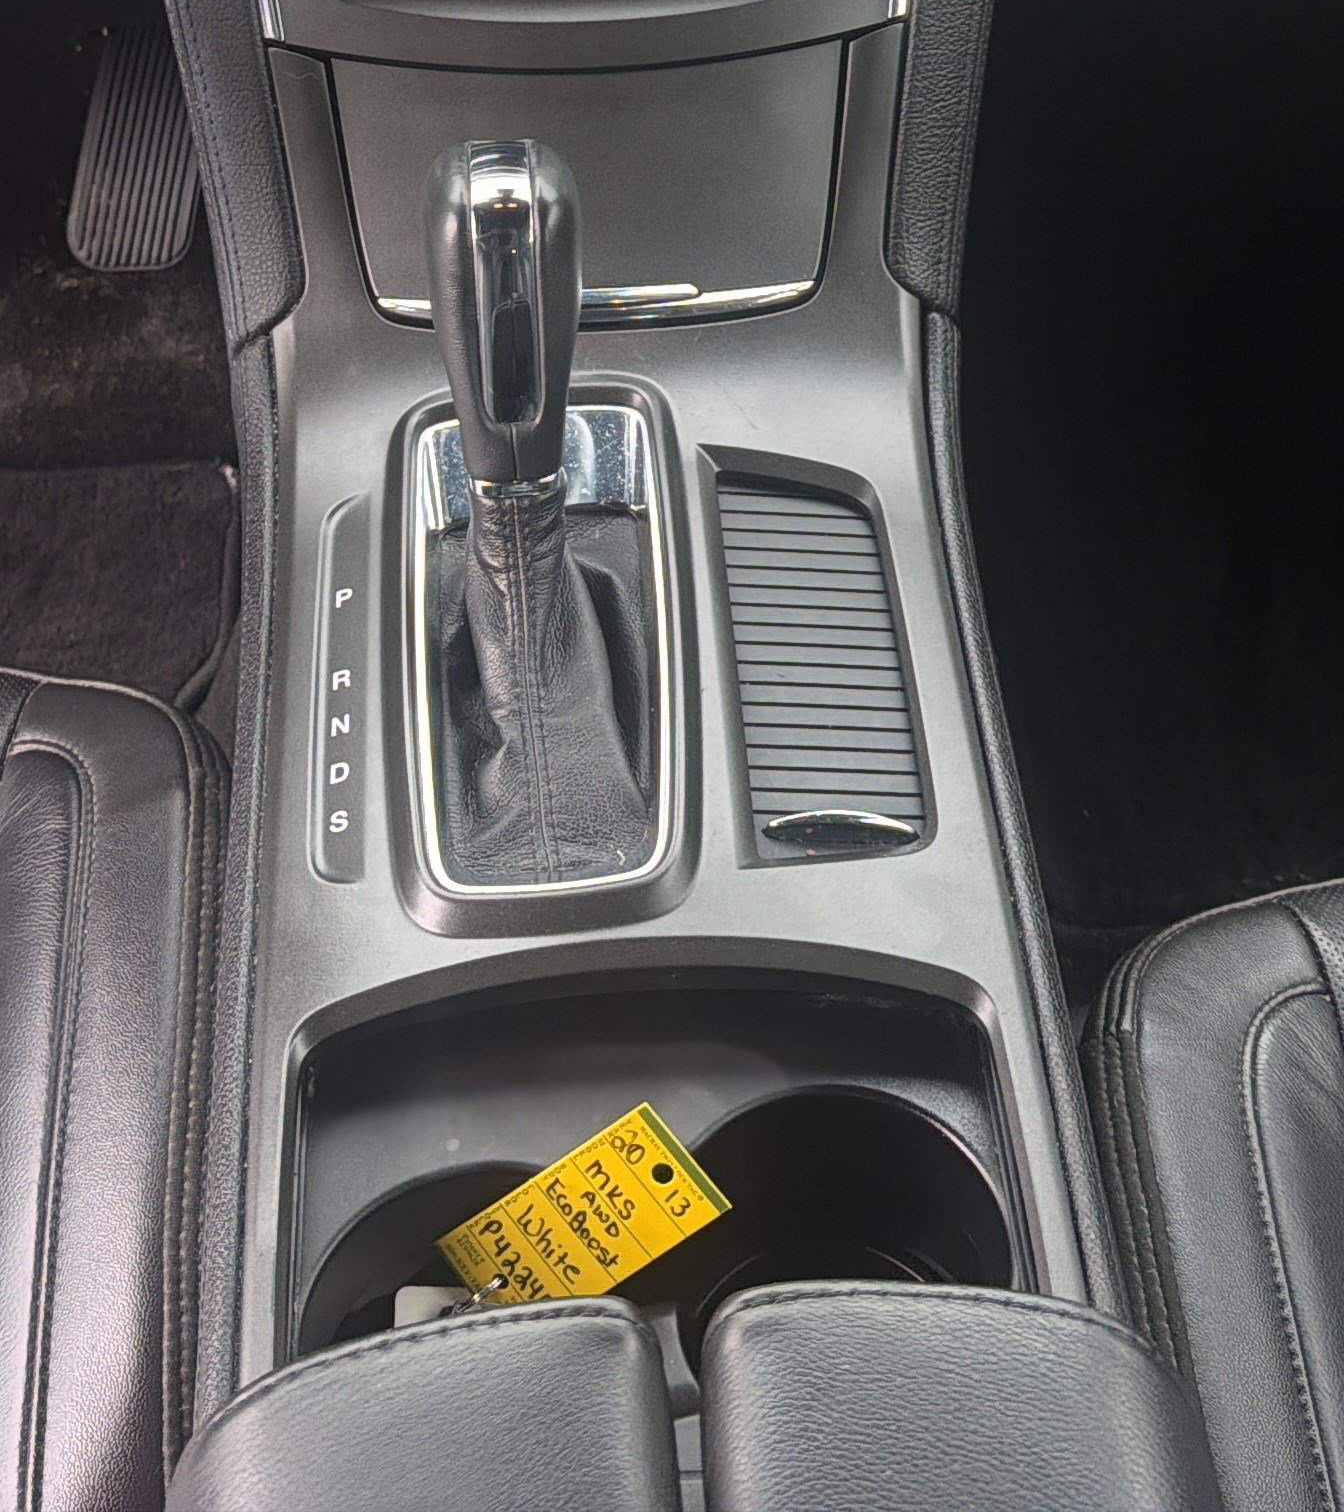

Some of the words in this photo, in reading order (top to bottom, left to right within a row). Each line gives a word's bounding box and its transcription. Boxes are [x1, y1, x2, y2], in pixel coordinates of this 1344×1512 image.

[335, 587, 354, 609] P
[332, 668, 352, 691] R
[330, 713, 351, 738] N
[328, 761, 351, 785] D
[328, 809, 350, 834] S
[580, 1190, 621, 1239] AWD
[665, 1188, 692, 1218] 13
[545, 1177, 620, 1268] EcoBoost
[516, 1203, 581, 1285] White
[478, 1219, 552, 1300] P4224
